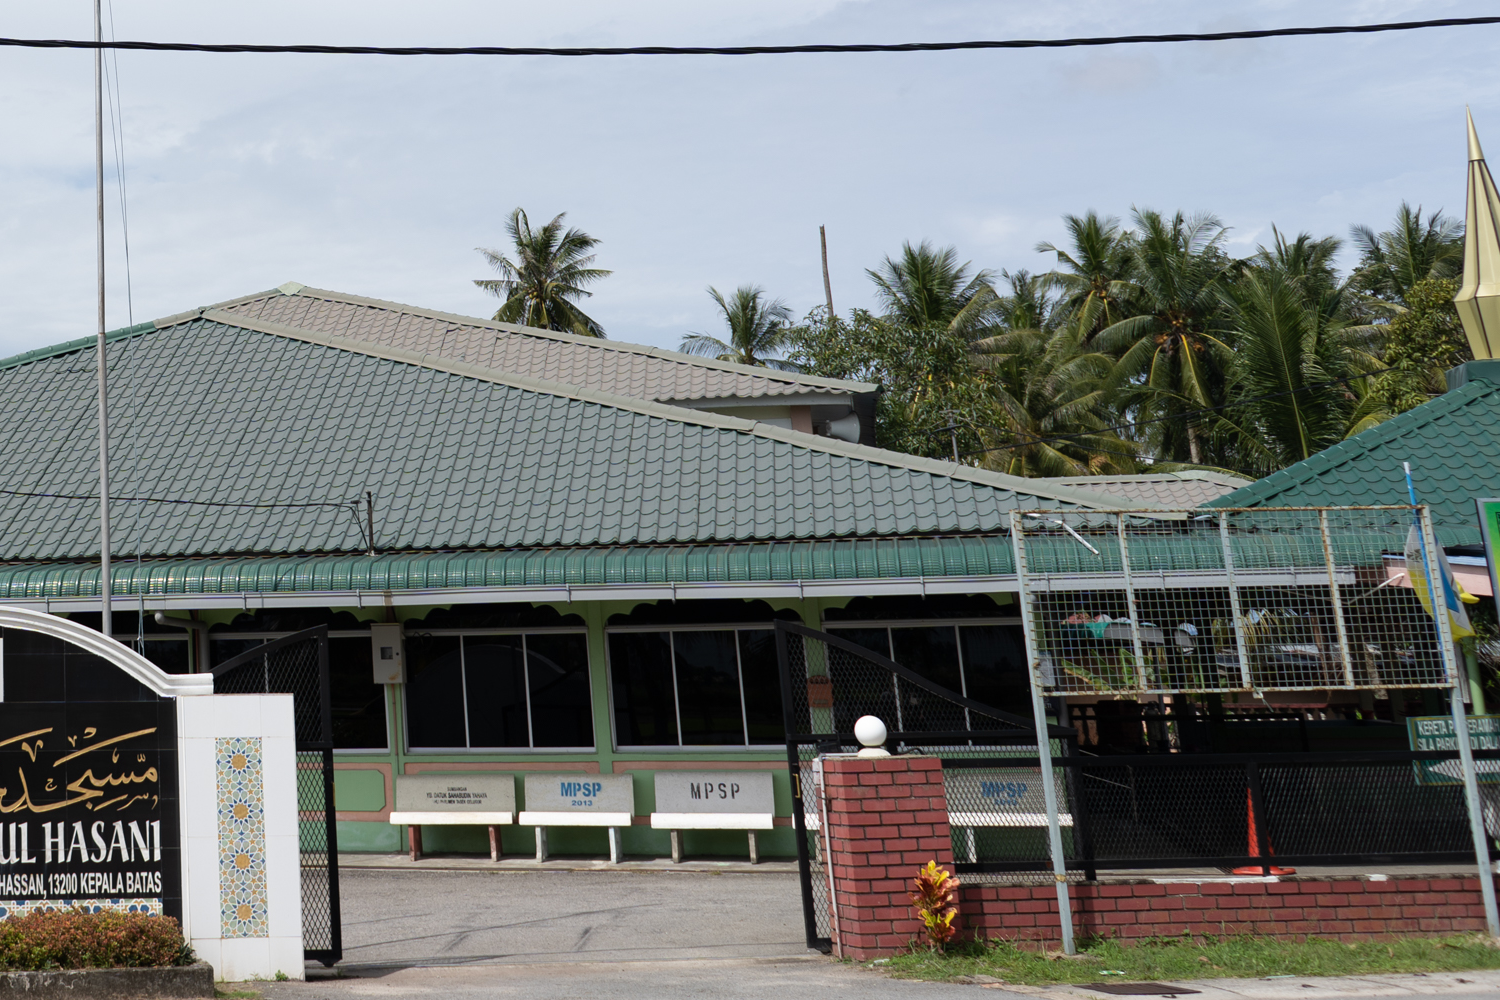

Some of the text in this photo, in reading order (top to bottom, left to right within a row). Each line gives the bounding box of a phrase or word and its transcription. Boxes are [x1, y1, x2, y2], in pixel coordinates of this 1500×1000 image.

[1417, 718, 1500, 735] KERETA PERAMAH
[1417, 738, 1435, 751] SILA
[1435, 737, 1460, 751] PARKI
[1470, 736, 1479, 750] DI
[560, 782, 602, 797] MPSP
[690, 782, 740, 800] MPSP
[981, 781, 1028, 798] MPSP
[571, 799, 593, 807] 2013
[41, 819, 162, 864] HASANI
[48, 873, 78, 895] 13200
[80, 872, 125, 895] KEPALA
[126, 871, 162, 894] BATAS
